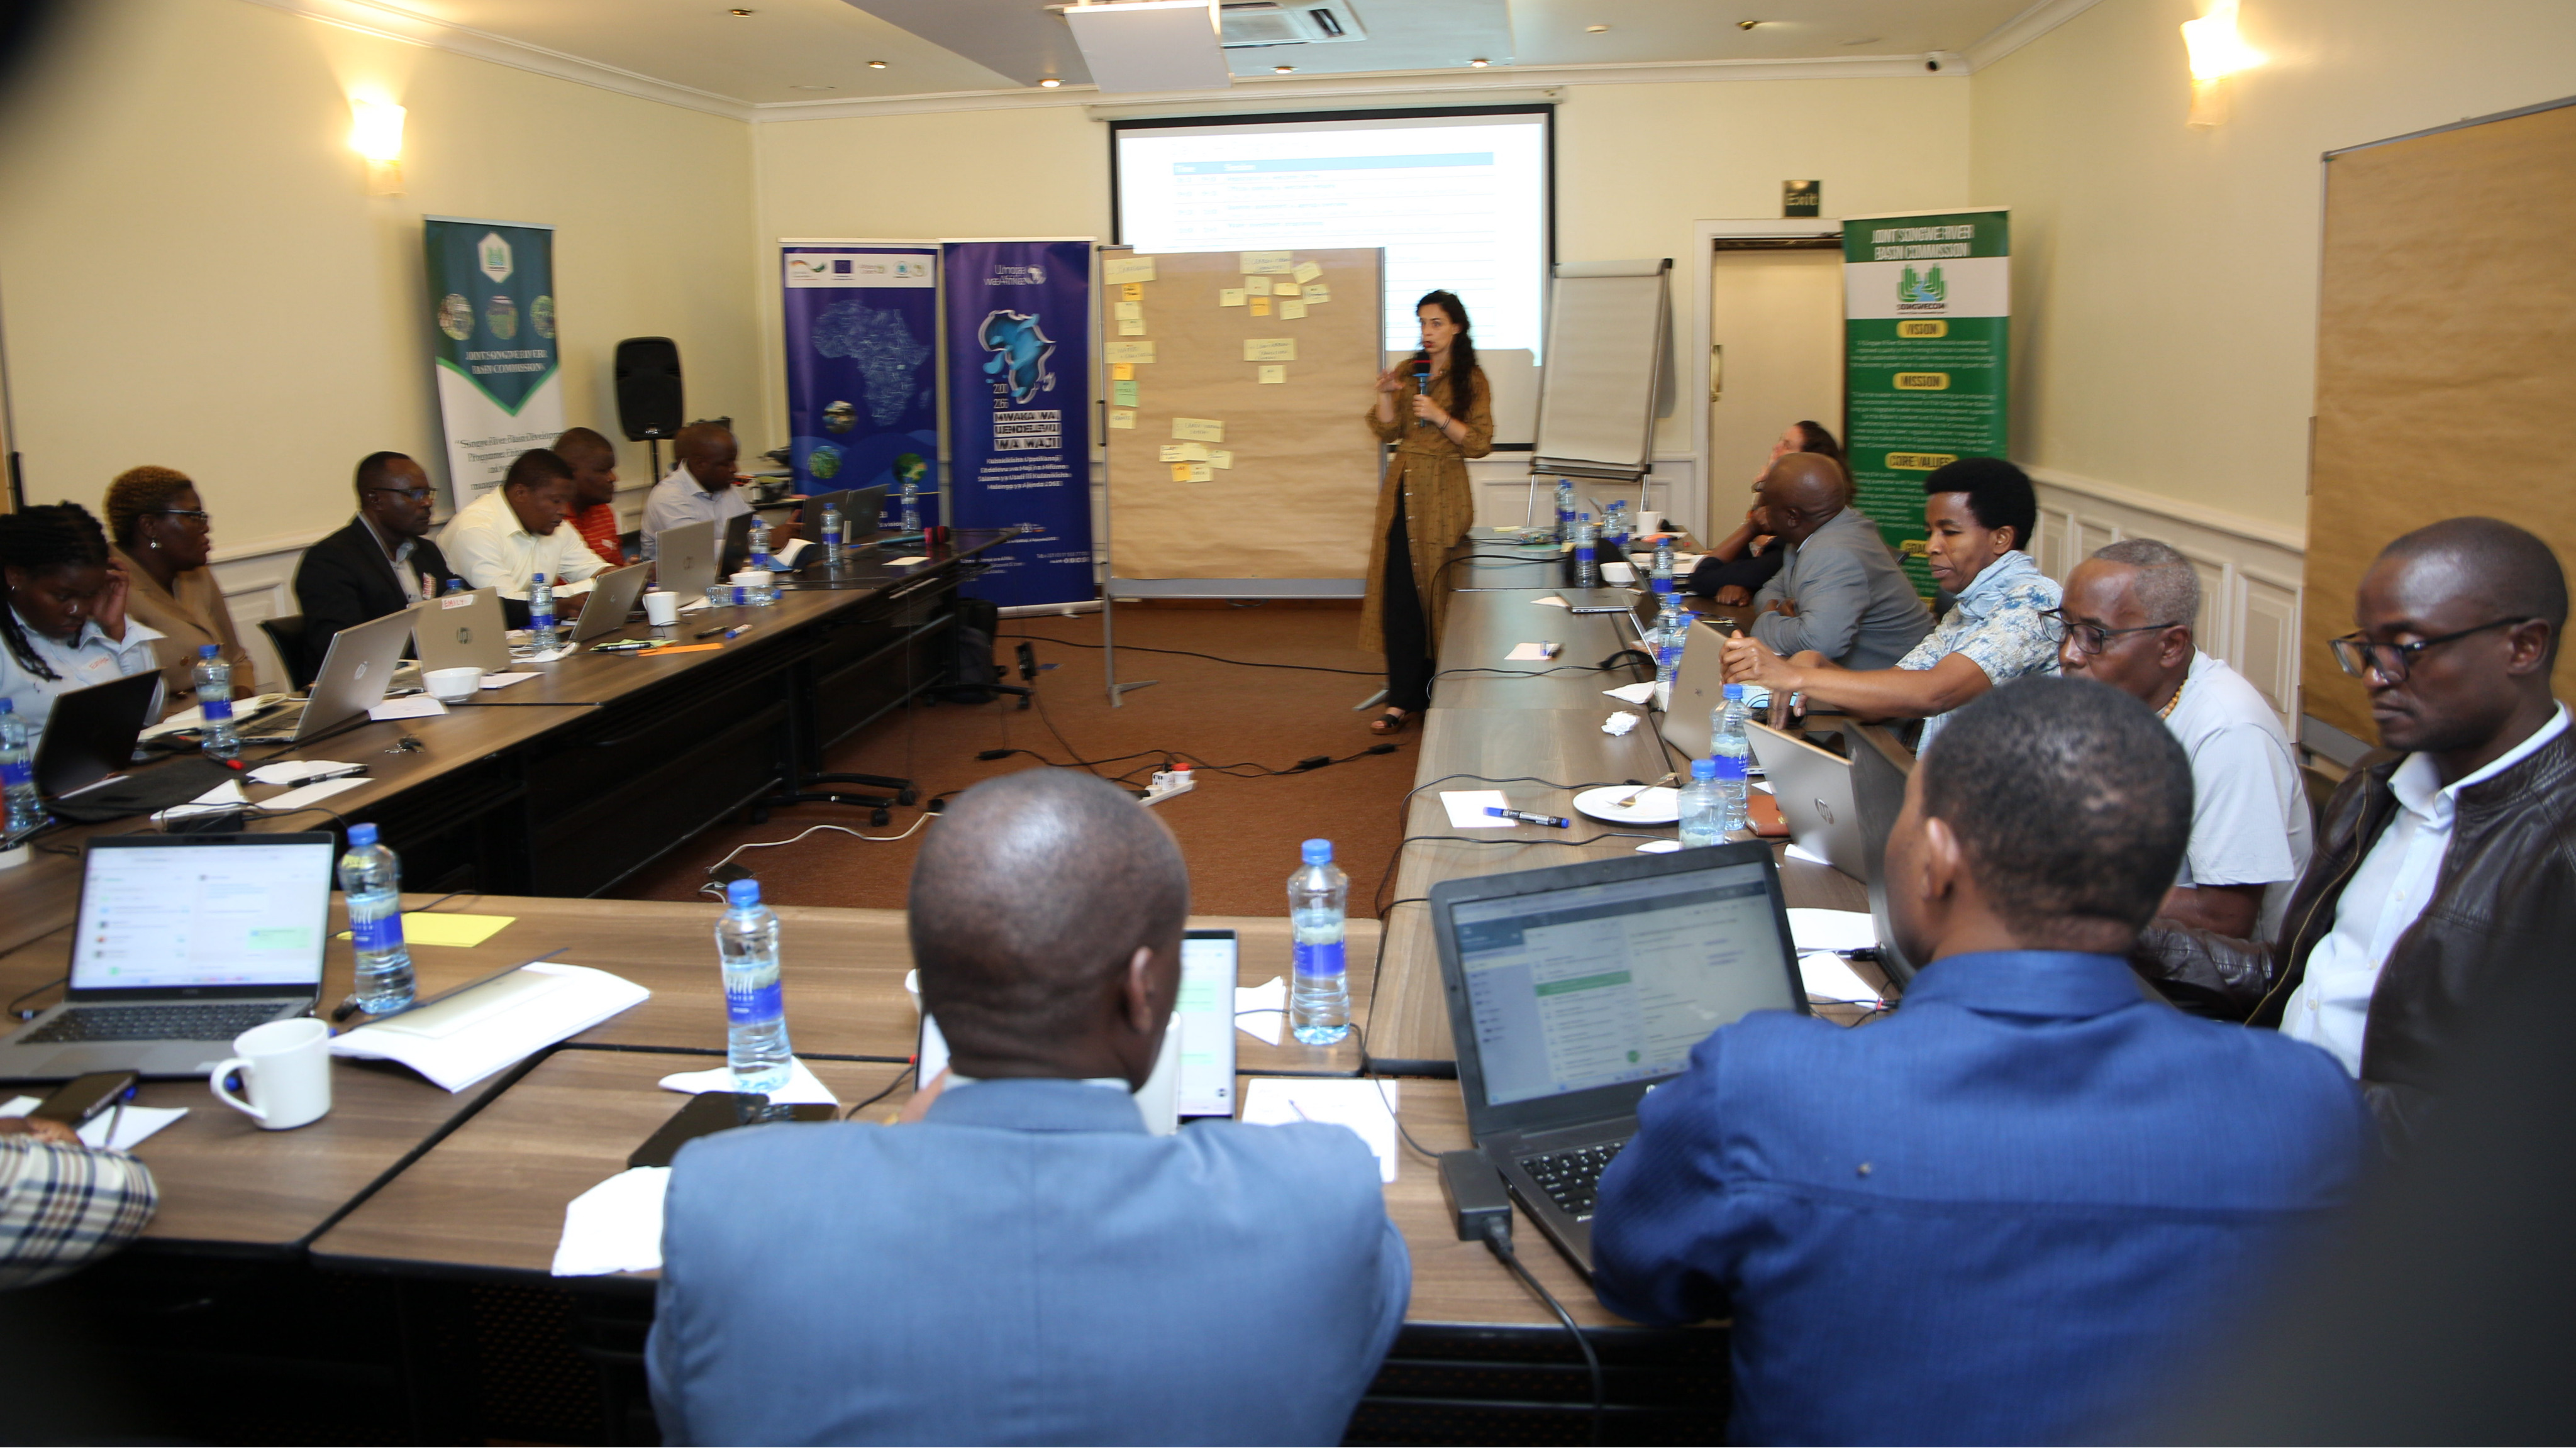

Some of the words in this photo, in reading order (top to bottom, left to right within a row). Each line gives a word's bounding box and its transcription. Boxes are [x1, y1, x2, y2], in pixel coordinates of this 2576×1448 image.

[1786, 192, 1818, 206] Exit
[1871, 228, 1898, 244] JOINT
[1905, 242, 1971, 260] COMMISSION
[995, 265, 1026, 276] Umoja
[1905, 323, 1938, 335] VISION
[1901, 375, 1940, 387] MISSION
[1890, 455, 1916, 467] CORE
[443, 599, 465, 607] EMILY
